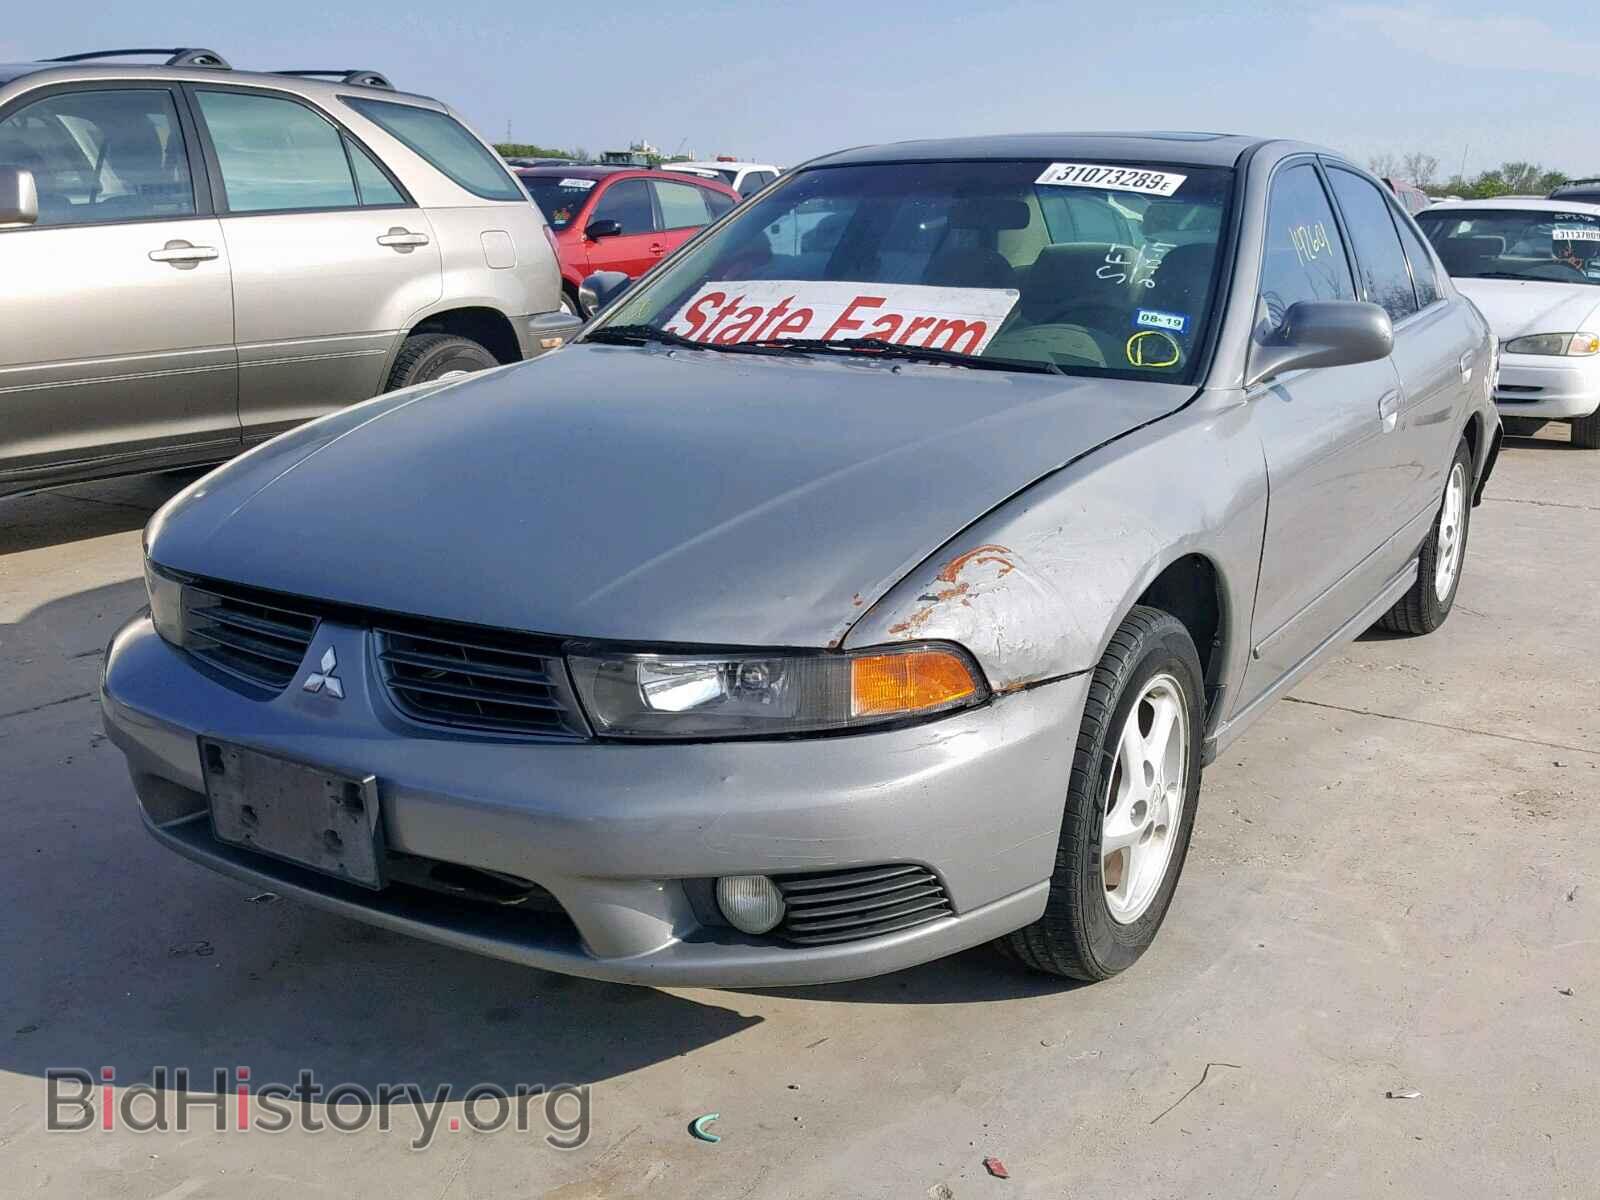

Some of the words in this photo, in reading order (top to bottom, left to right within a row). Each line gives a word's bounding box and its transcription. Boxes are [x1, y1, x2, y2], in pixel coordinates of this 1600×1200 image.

[669, 291, 815, 347] State
[821, 295, 988, 356] Farm
[1141, 313, 1181, 327] 08-19
